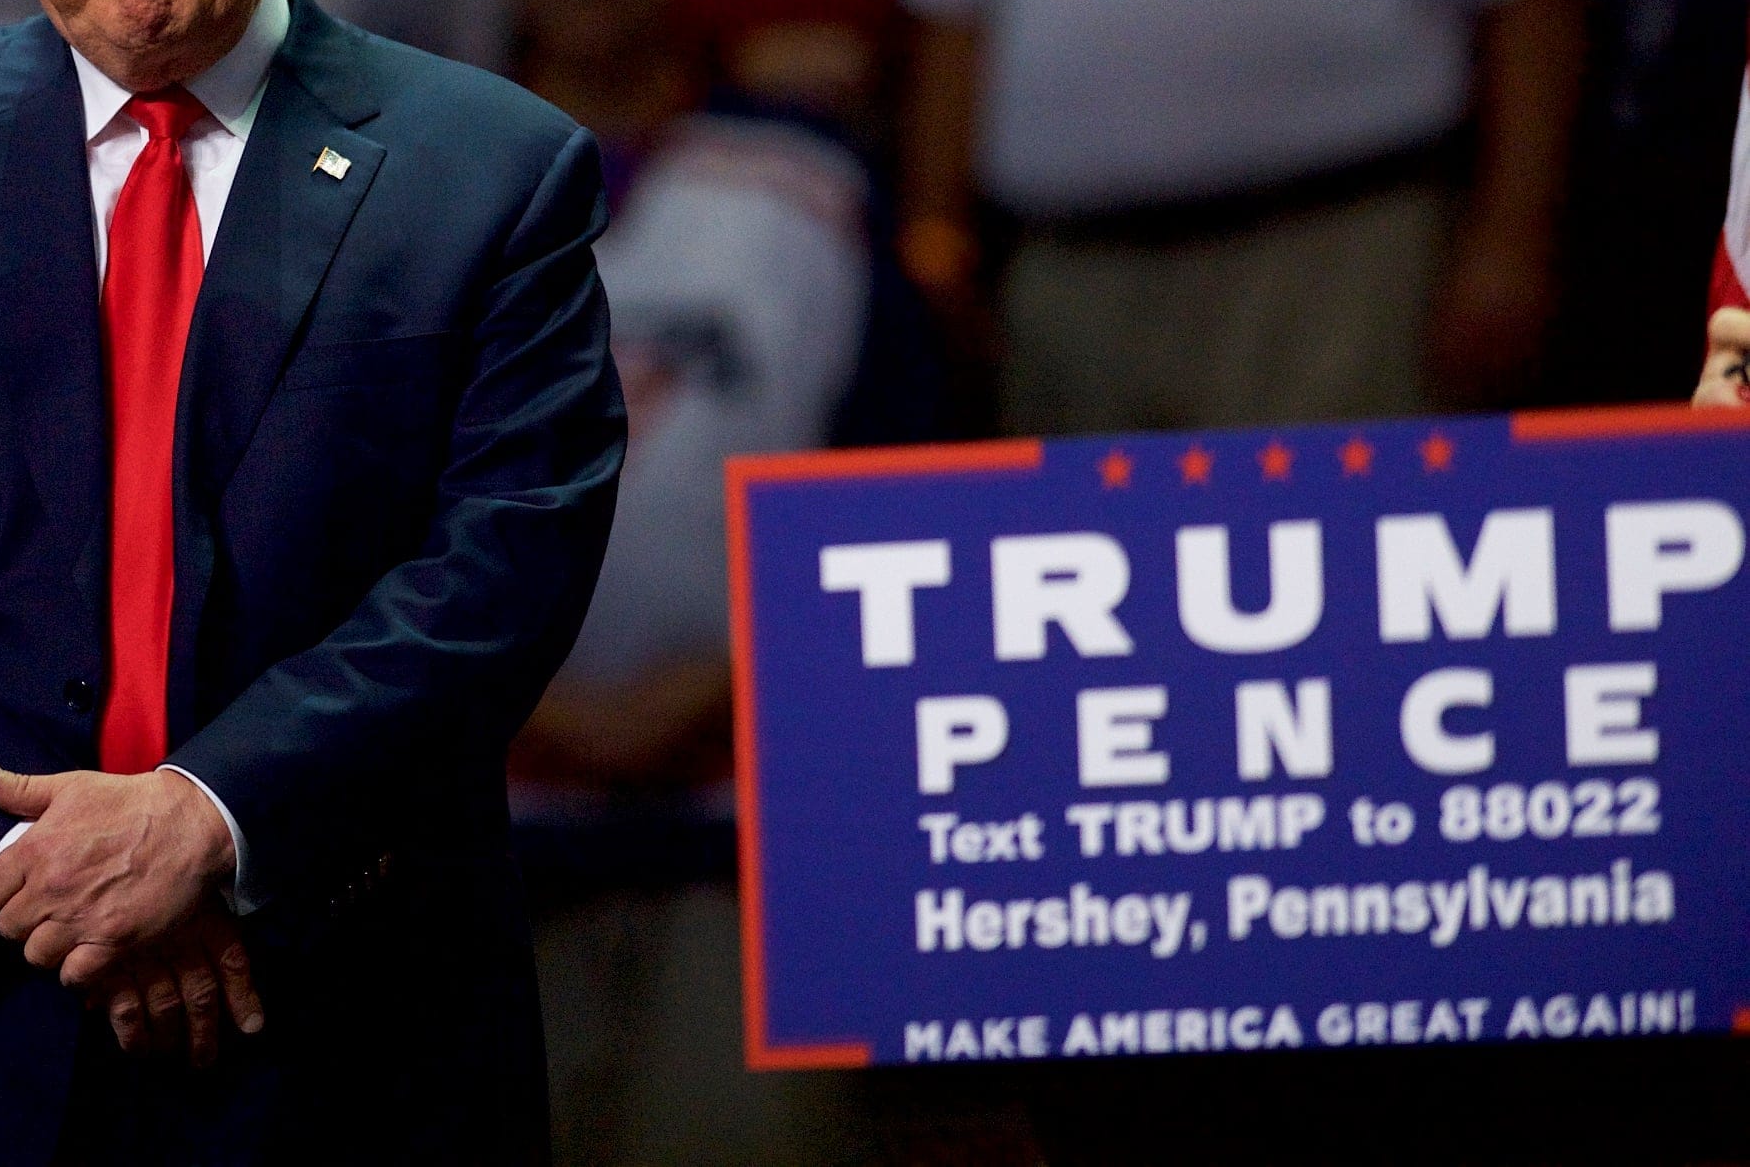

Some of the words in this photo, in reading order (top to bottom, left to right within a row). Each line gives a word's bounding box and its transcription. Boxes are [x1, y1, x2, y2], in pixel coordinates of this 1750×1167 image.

[818, 497, 1747, 669] TRUMP
[914, 660, 1661, 797] PENCE
[917, 811, 1046, 865] Text
[1064, 792, 1326, 858] TRUMP
[1348, 795, 1416, 847] to
[1438, 776, 1662, 843] 88022
[914, 881, 1209, 959] Hershey,
[1225, 857, 1676, 949] Pennsylvania
[903, 1014, 1049, 1063] MAKE
[1062, 1004, 1304, 1057] AMERICA
[1316, 997, 1491, 1047] GREAT
[1505, 989, 1696, 1040] AGAIN!
